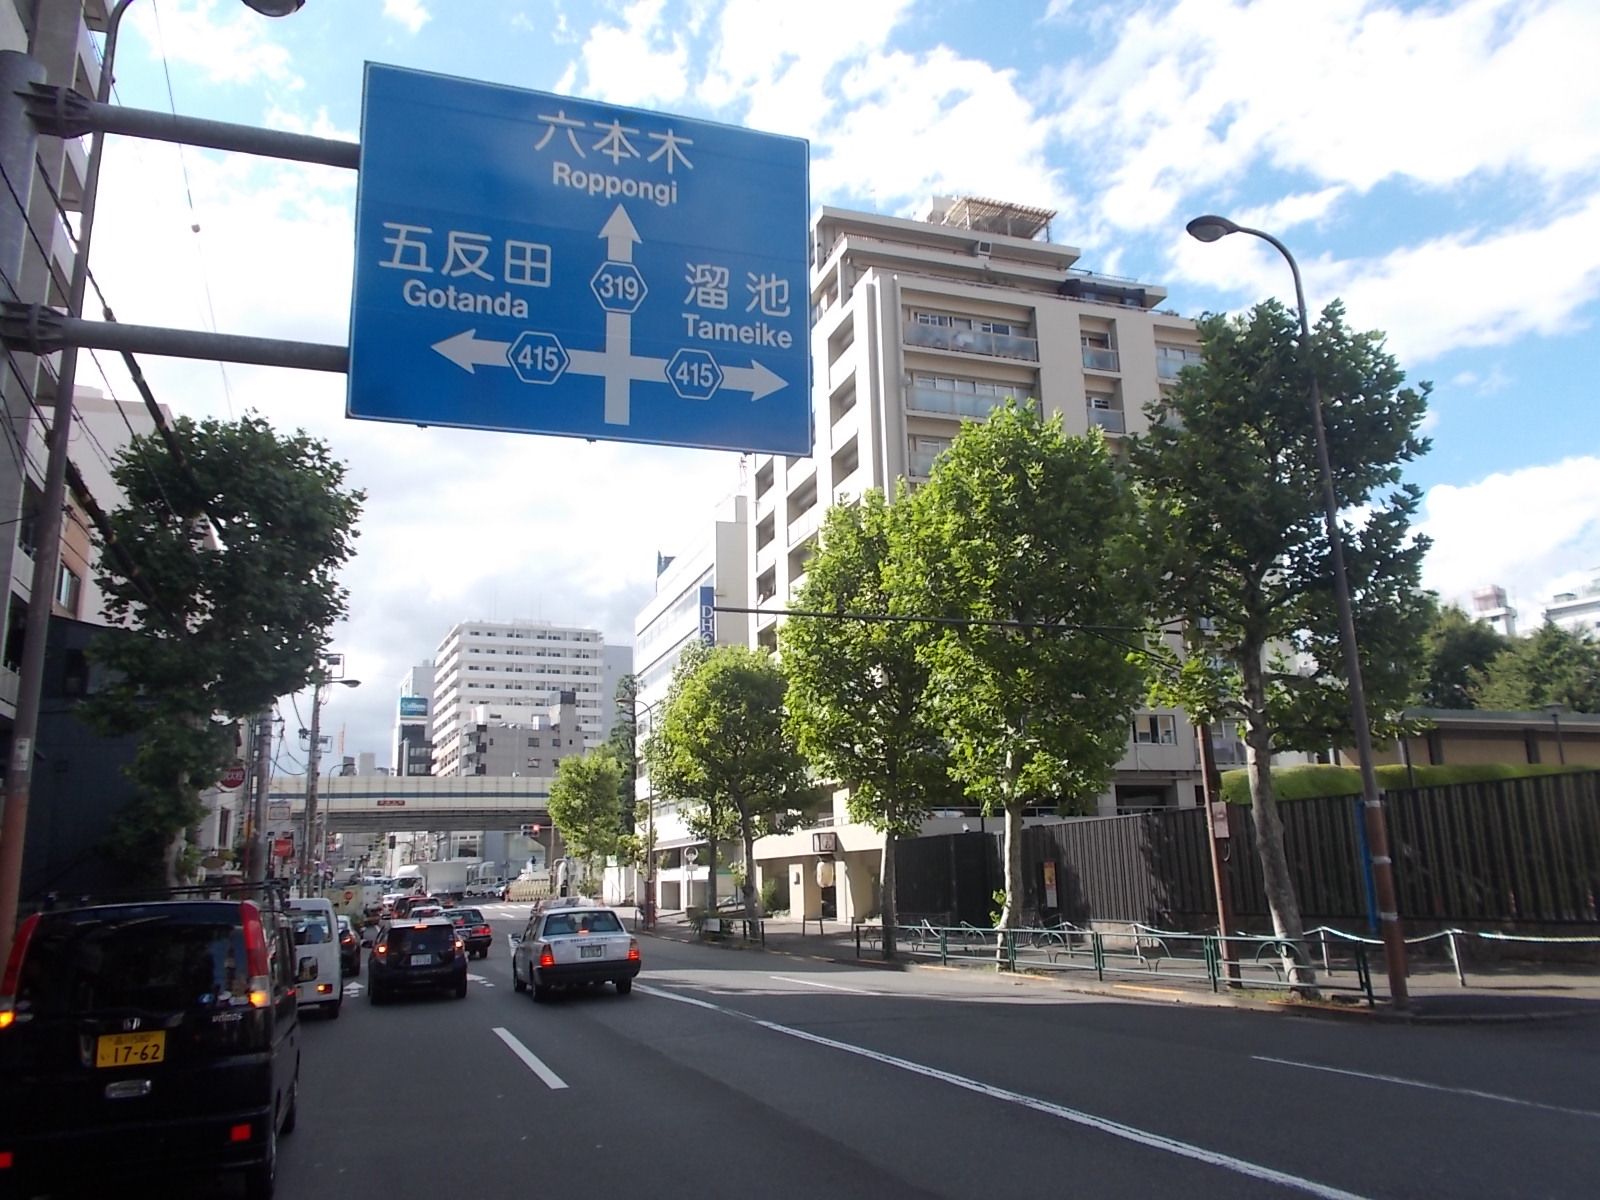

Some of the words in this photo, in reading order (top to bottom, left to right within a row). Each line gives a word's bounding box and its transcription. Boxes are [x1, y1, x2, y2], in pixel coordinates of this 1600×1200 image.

[534, 110, 694, 174] 六本木
[553, 162, 678, 207] Roppongi
[379, 222, 551, 289] 五反田
[403, 279, 528, 318] Gotanda
[600, 274, 637, 300] 319
[684, 262, 790, 317] 溜池
[682, 313, 793, 349] Tameike
[517, 344, 559, 370] 415
[675, 361, 714, 387] 415
[114, 1043, 160, 1063] 17-62
